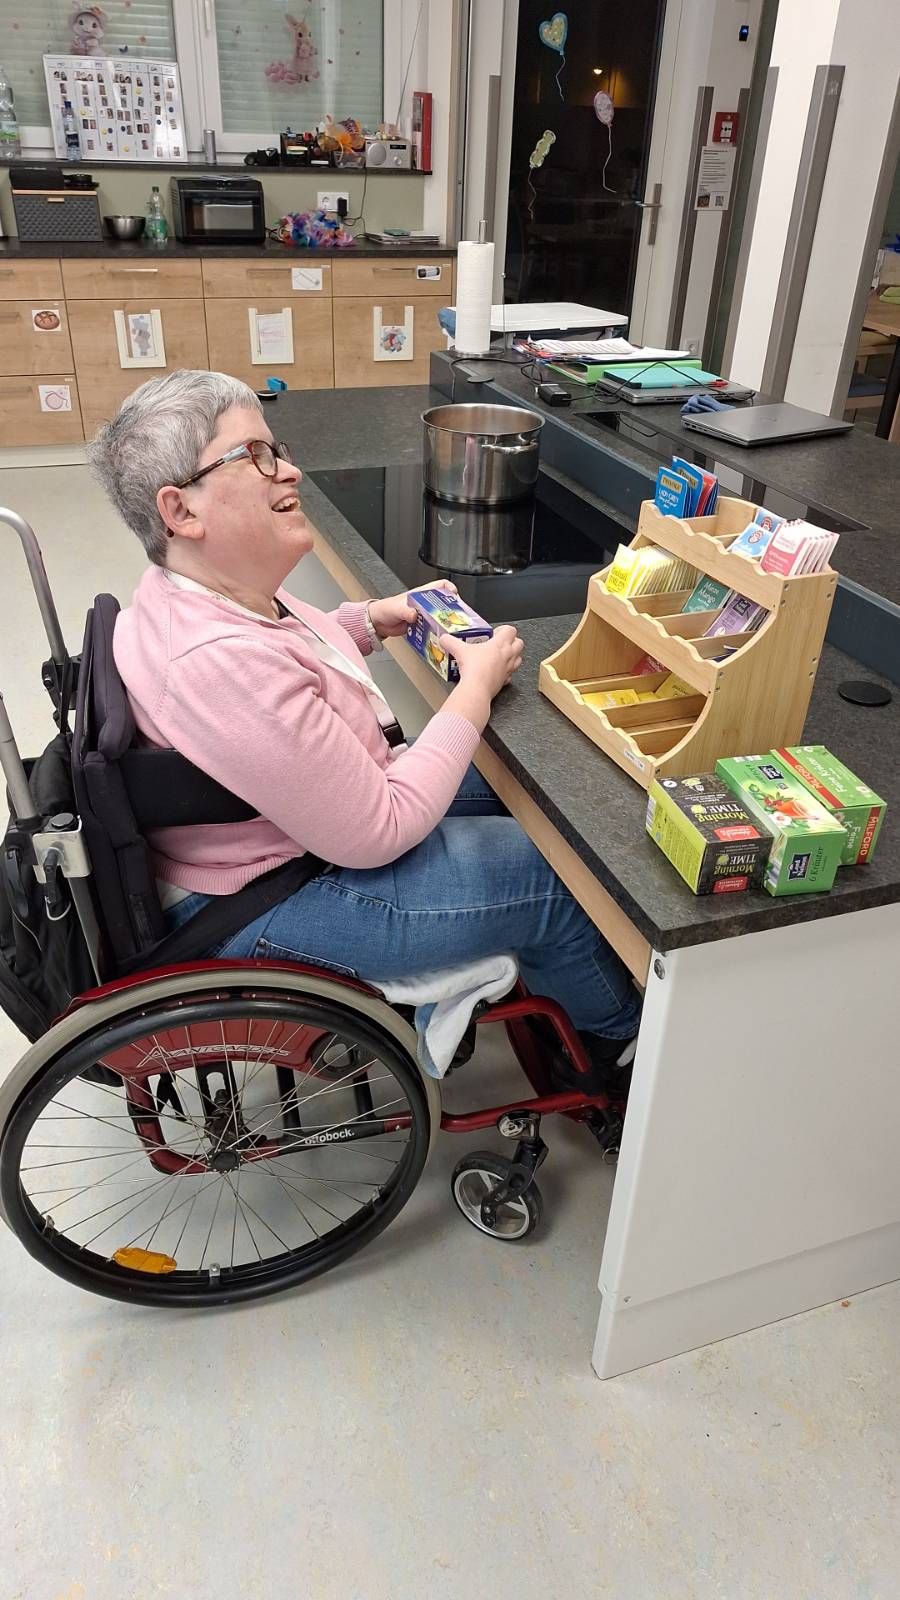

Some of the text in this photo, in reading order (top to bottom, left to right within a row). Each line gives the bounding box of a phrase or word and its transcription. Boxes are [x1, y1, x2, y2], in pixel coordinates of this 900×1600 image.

[705, 803, 743, 814] TIME
[694, 810, 749, 823] Morning
[847, 826, 861, 849] Feine
[860, 816, 879, 856] MILFORD
[730, 854, 757, 865] TIME
[714, 863, 755, 876] Morning
